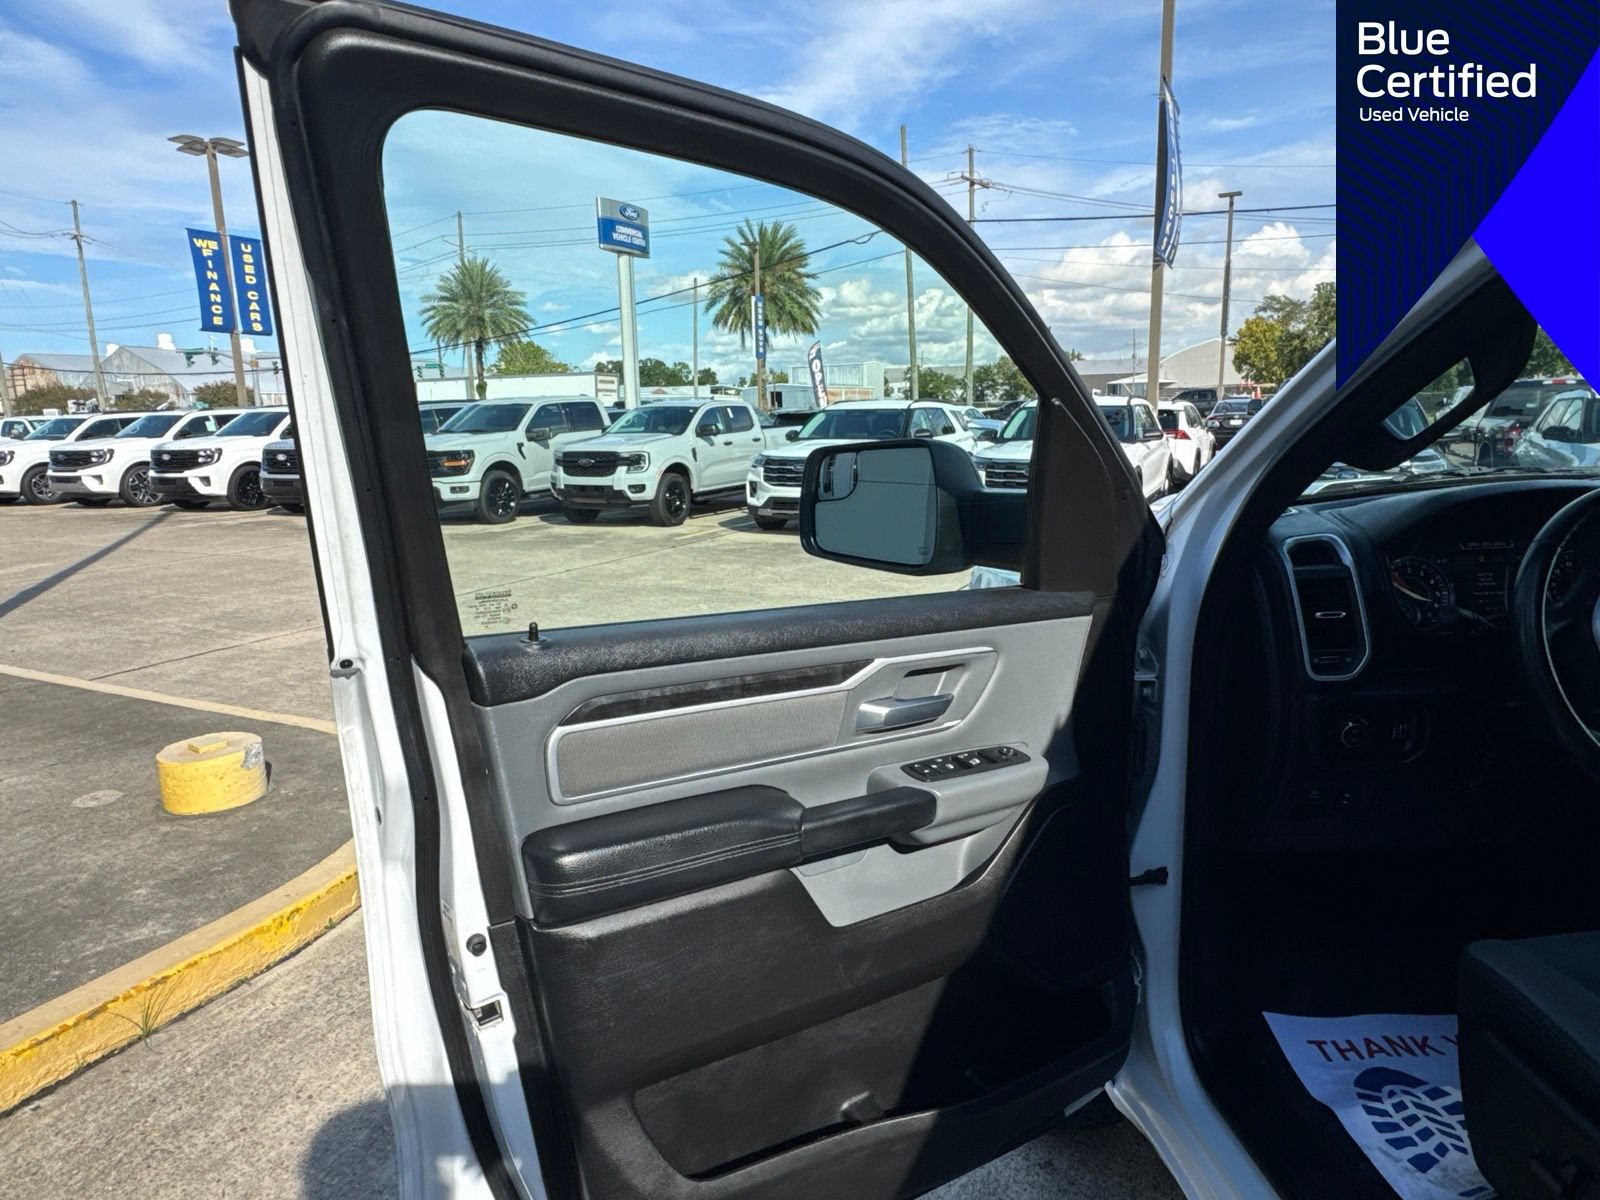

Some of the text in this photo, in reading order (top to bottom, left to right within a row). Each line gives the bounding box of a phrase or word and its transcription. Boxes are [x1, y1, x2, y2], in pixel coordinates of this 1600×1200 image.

[192, 237, 219, 250] WE
[612, 231, 631, 243] VEHICLE
[201, 249, 223, 326] FINANCE
[240, 243, 263, 332] USED CARS
[812, 358, 828, 408] OPEN
[1306, 1035, 1447, 1062] THANK
